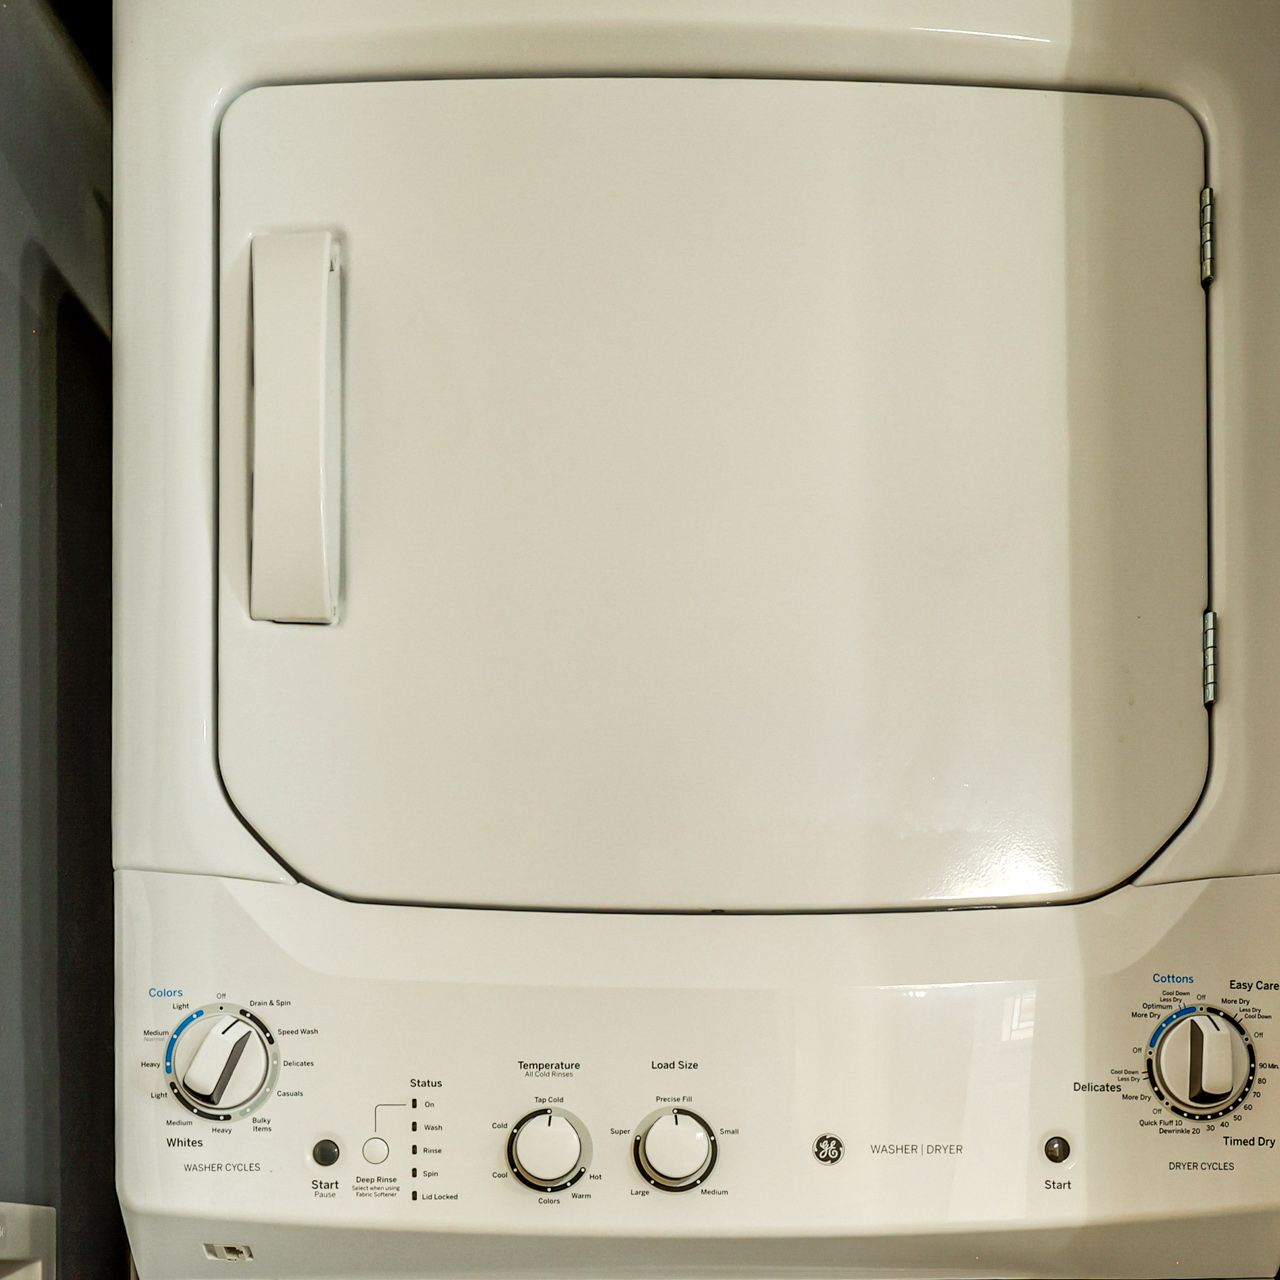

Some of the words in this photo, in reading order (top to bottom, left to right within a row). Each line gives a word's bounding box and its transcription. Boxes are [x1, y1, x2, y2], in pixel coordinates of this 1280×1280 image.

[1152, 973, 1194, 984] Cottons
[1229, 980, 1253, 991] Easy
[1255, 981, 1280, 990] Care
[148, 988, 183, 997] Colors
[1150, 1012, 1161, 1020] Dry
[140, 1061, 161, 1069] Heavy
[518, 1061, 581, 1072] Temperature
[651, 1061, 675, 1069] Load
[678, 1061, 699, 1069] Size
[410, 1079, 443, 1088] Status
[1073, 1082, 1122, 1092] Delicates
[1140, 1094, 1152, 1102] Dry
[252, 1117, 271, 1125] Bulky
[1139, 1120, 1158, 1128] Quick
[211, 1127, 232, 1135] Heavy
[166, 1138, 203, 1148] Whites
[1223, 1136, 1255, 1146] Timed
[1258, 1137, 1276, 1148] Dry
[870, 1144, 918, 1154] WASHER
[926, 1144, 963, 1154] DRYER
[184, 1164, 223, 1172] WASHER
[225, 1163, 261, 1172] CYCLES
[1168, 1162, 1198, 1171] DRYER
[1200, 1162, 1235, 1171] CYCLES
[356, 1176, 375, 1184] Deep
[1044, 1179, 1072, 1190] Start
[311, 1180, 339, 1190] Start
[630, 1189, 650, 1197] Large
